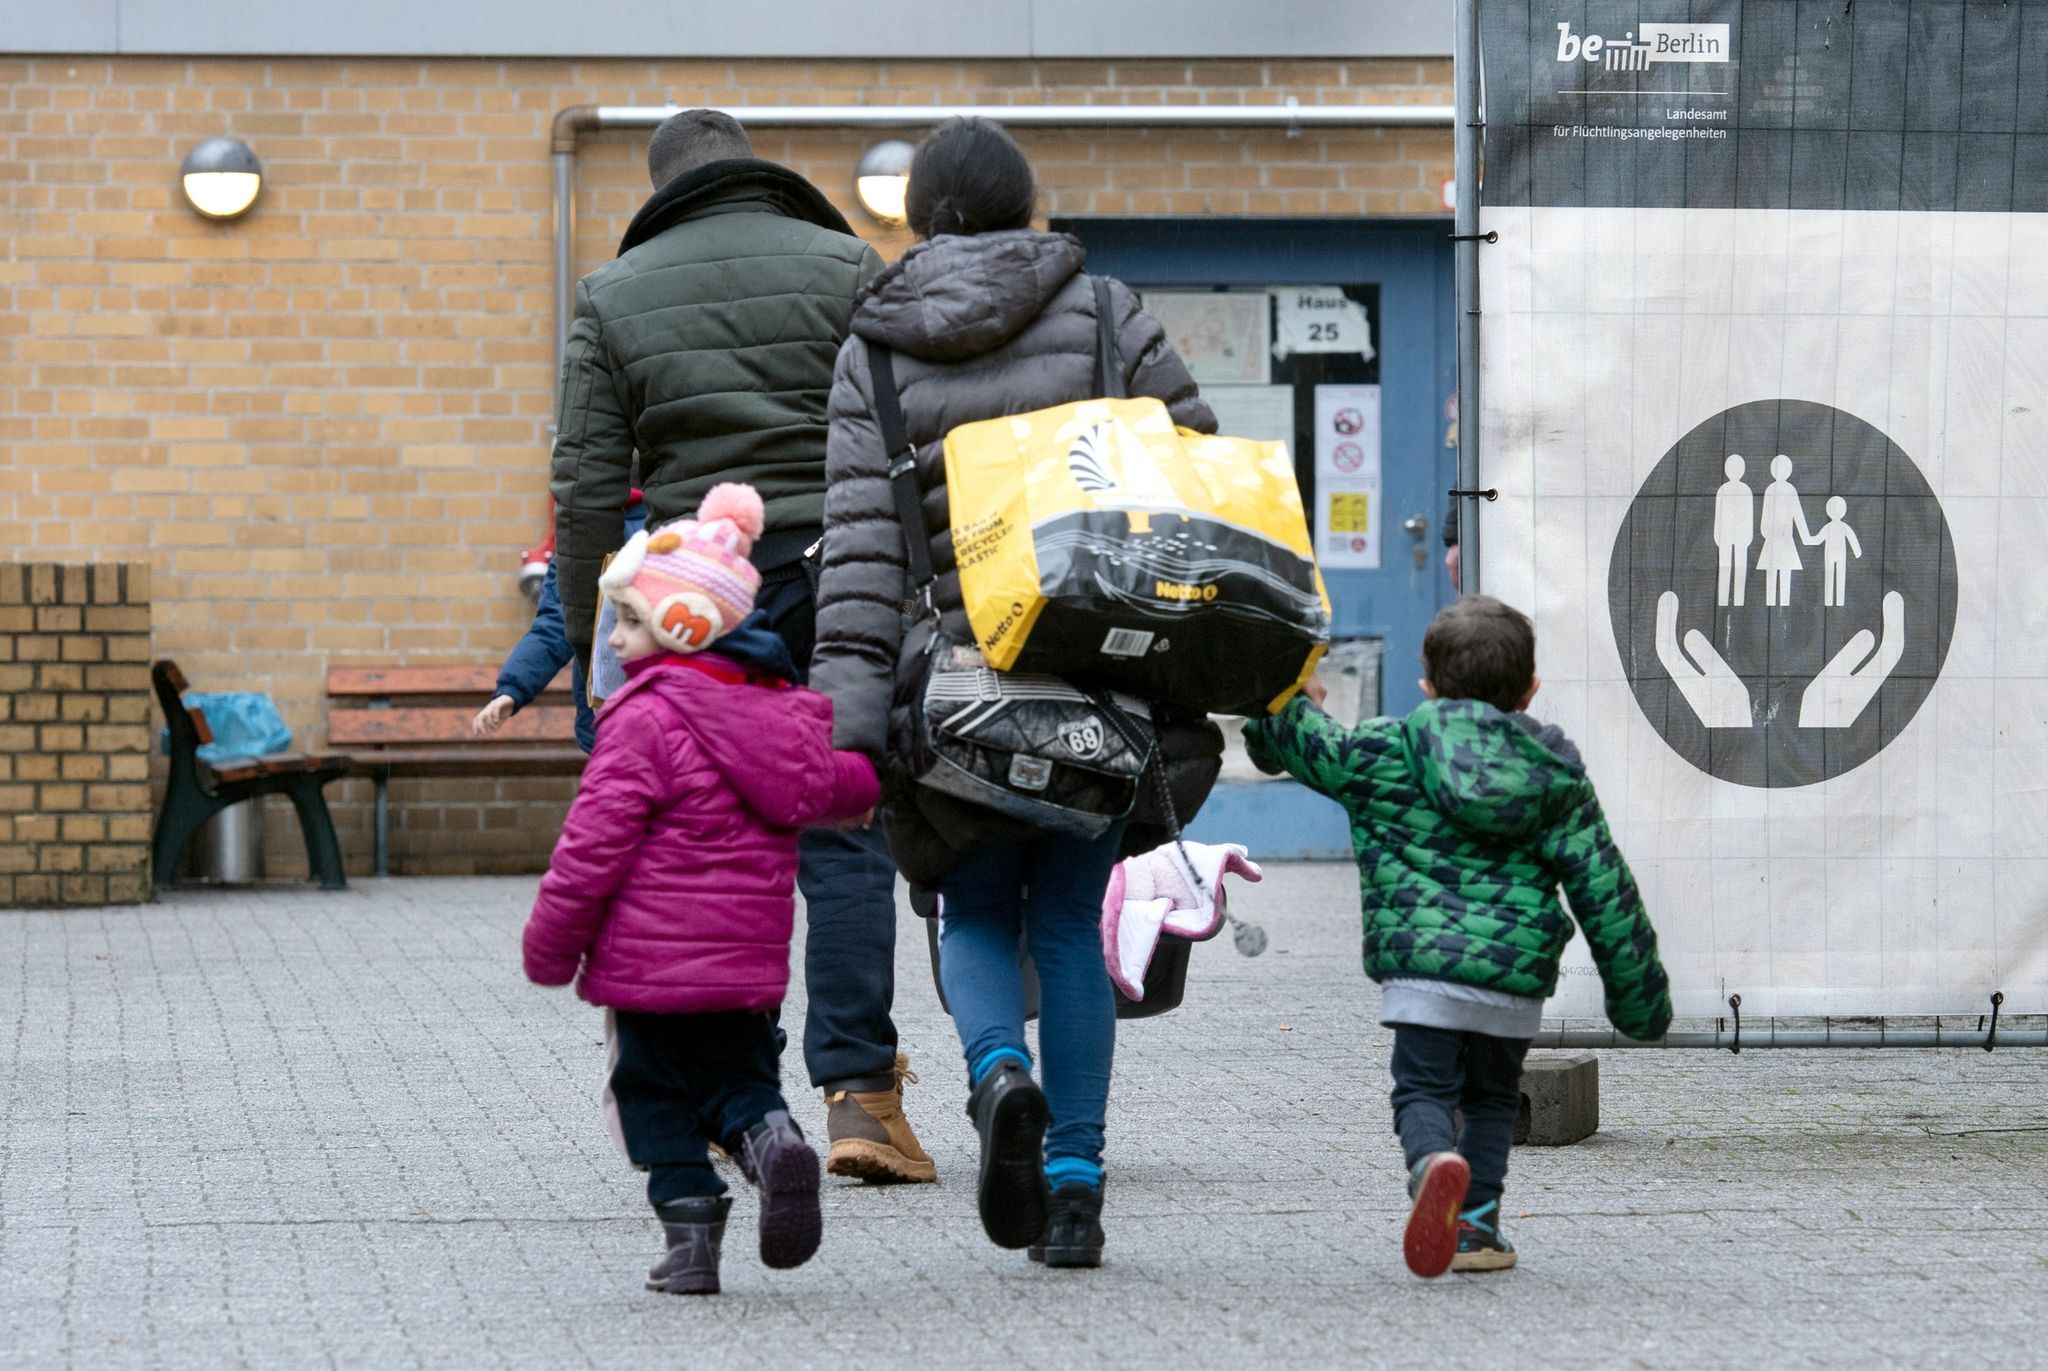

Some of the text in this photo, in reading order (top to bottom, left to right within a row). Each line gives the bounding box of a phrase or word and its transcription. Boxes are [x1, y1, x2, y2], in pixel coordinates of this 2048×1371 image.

[1557, 22, 1720, 62] be Berlin
[1666, 108, 1727, 120] Landesamt
[1553, 125, 1727, 141] für Flüchtlingsangelegenheiten
[1298, 294, 1348, 309] Haus
[1308, 323, 1339, 341] 25
[1156, 580, 1202, 601] Netto
[985, 616, 1013, 651] Netto
[1069, 727, 1098, 753] 69
